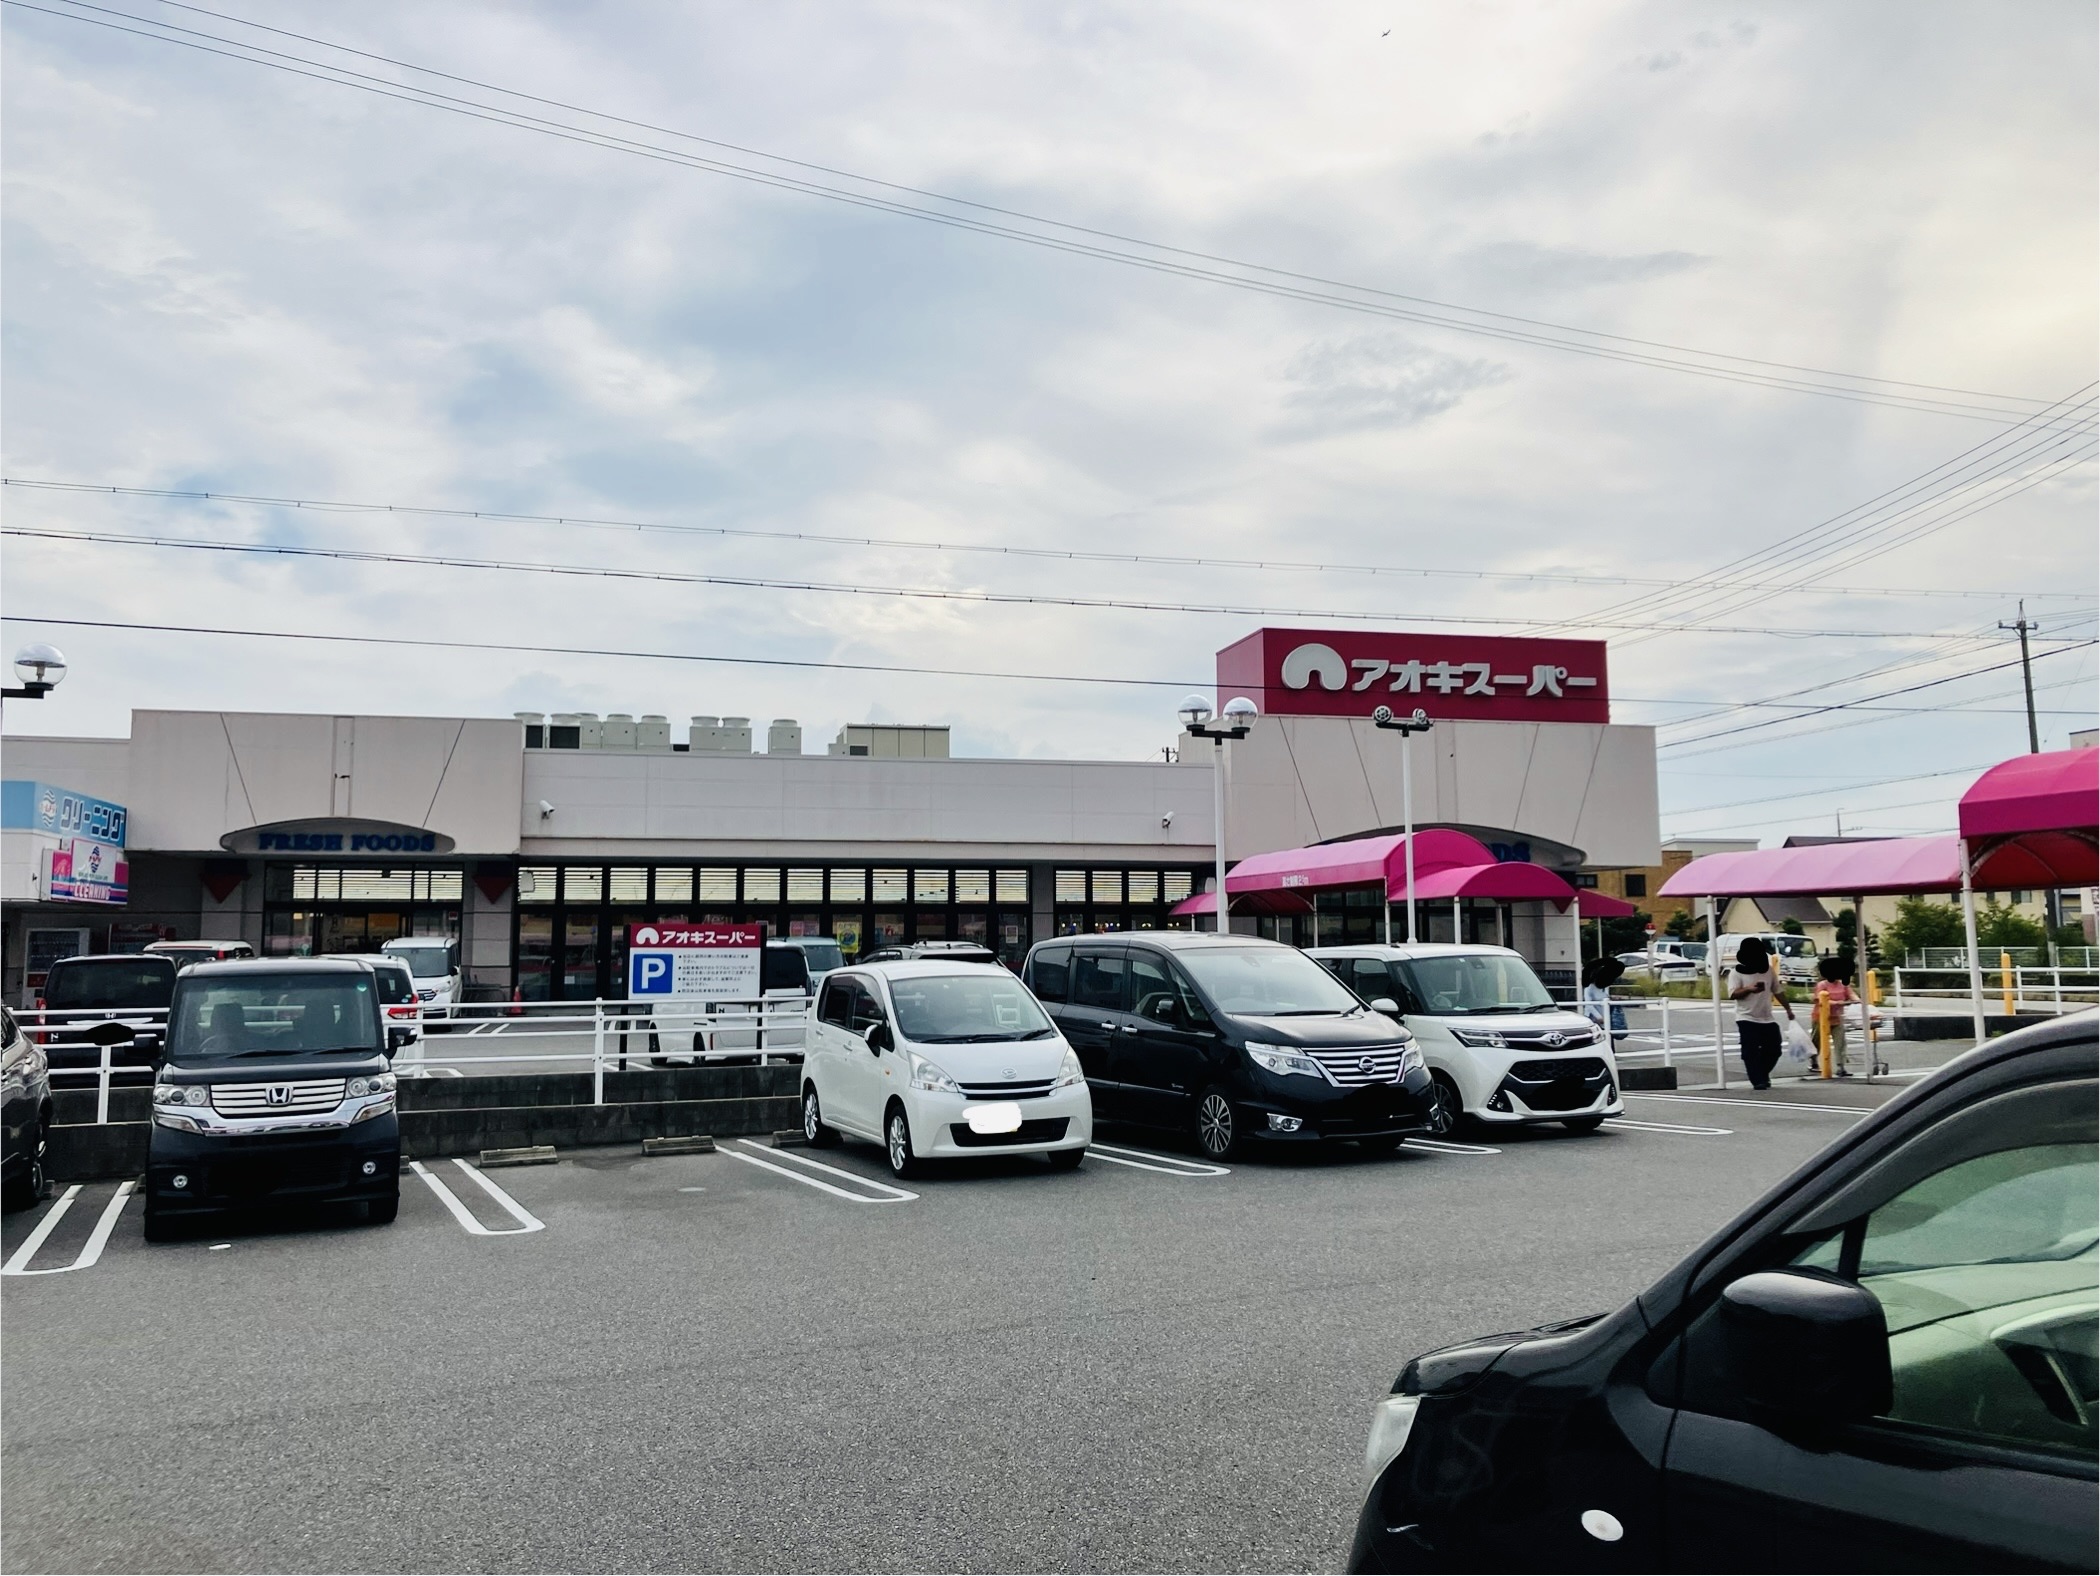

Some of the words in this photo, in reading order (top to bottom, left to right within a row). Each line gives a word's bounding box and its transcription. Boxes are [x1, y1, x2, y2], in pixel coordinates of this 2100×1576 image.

[1351, 658, 1597, 697] アオキスーパー
[60, 796, 125, 842] クリーニング
[258, 833, 343, 850] FRESH
[351, 833, 436, 852] FOODS
[662, 931, 756, 944] アオキスーパー
[641, 957, 666, 989] P
